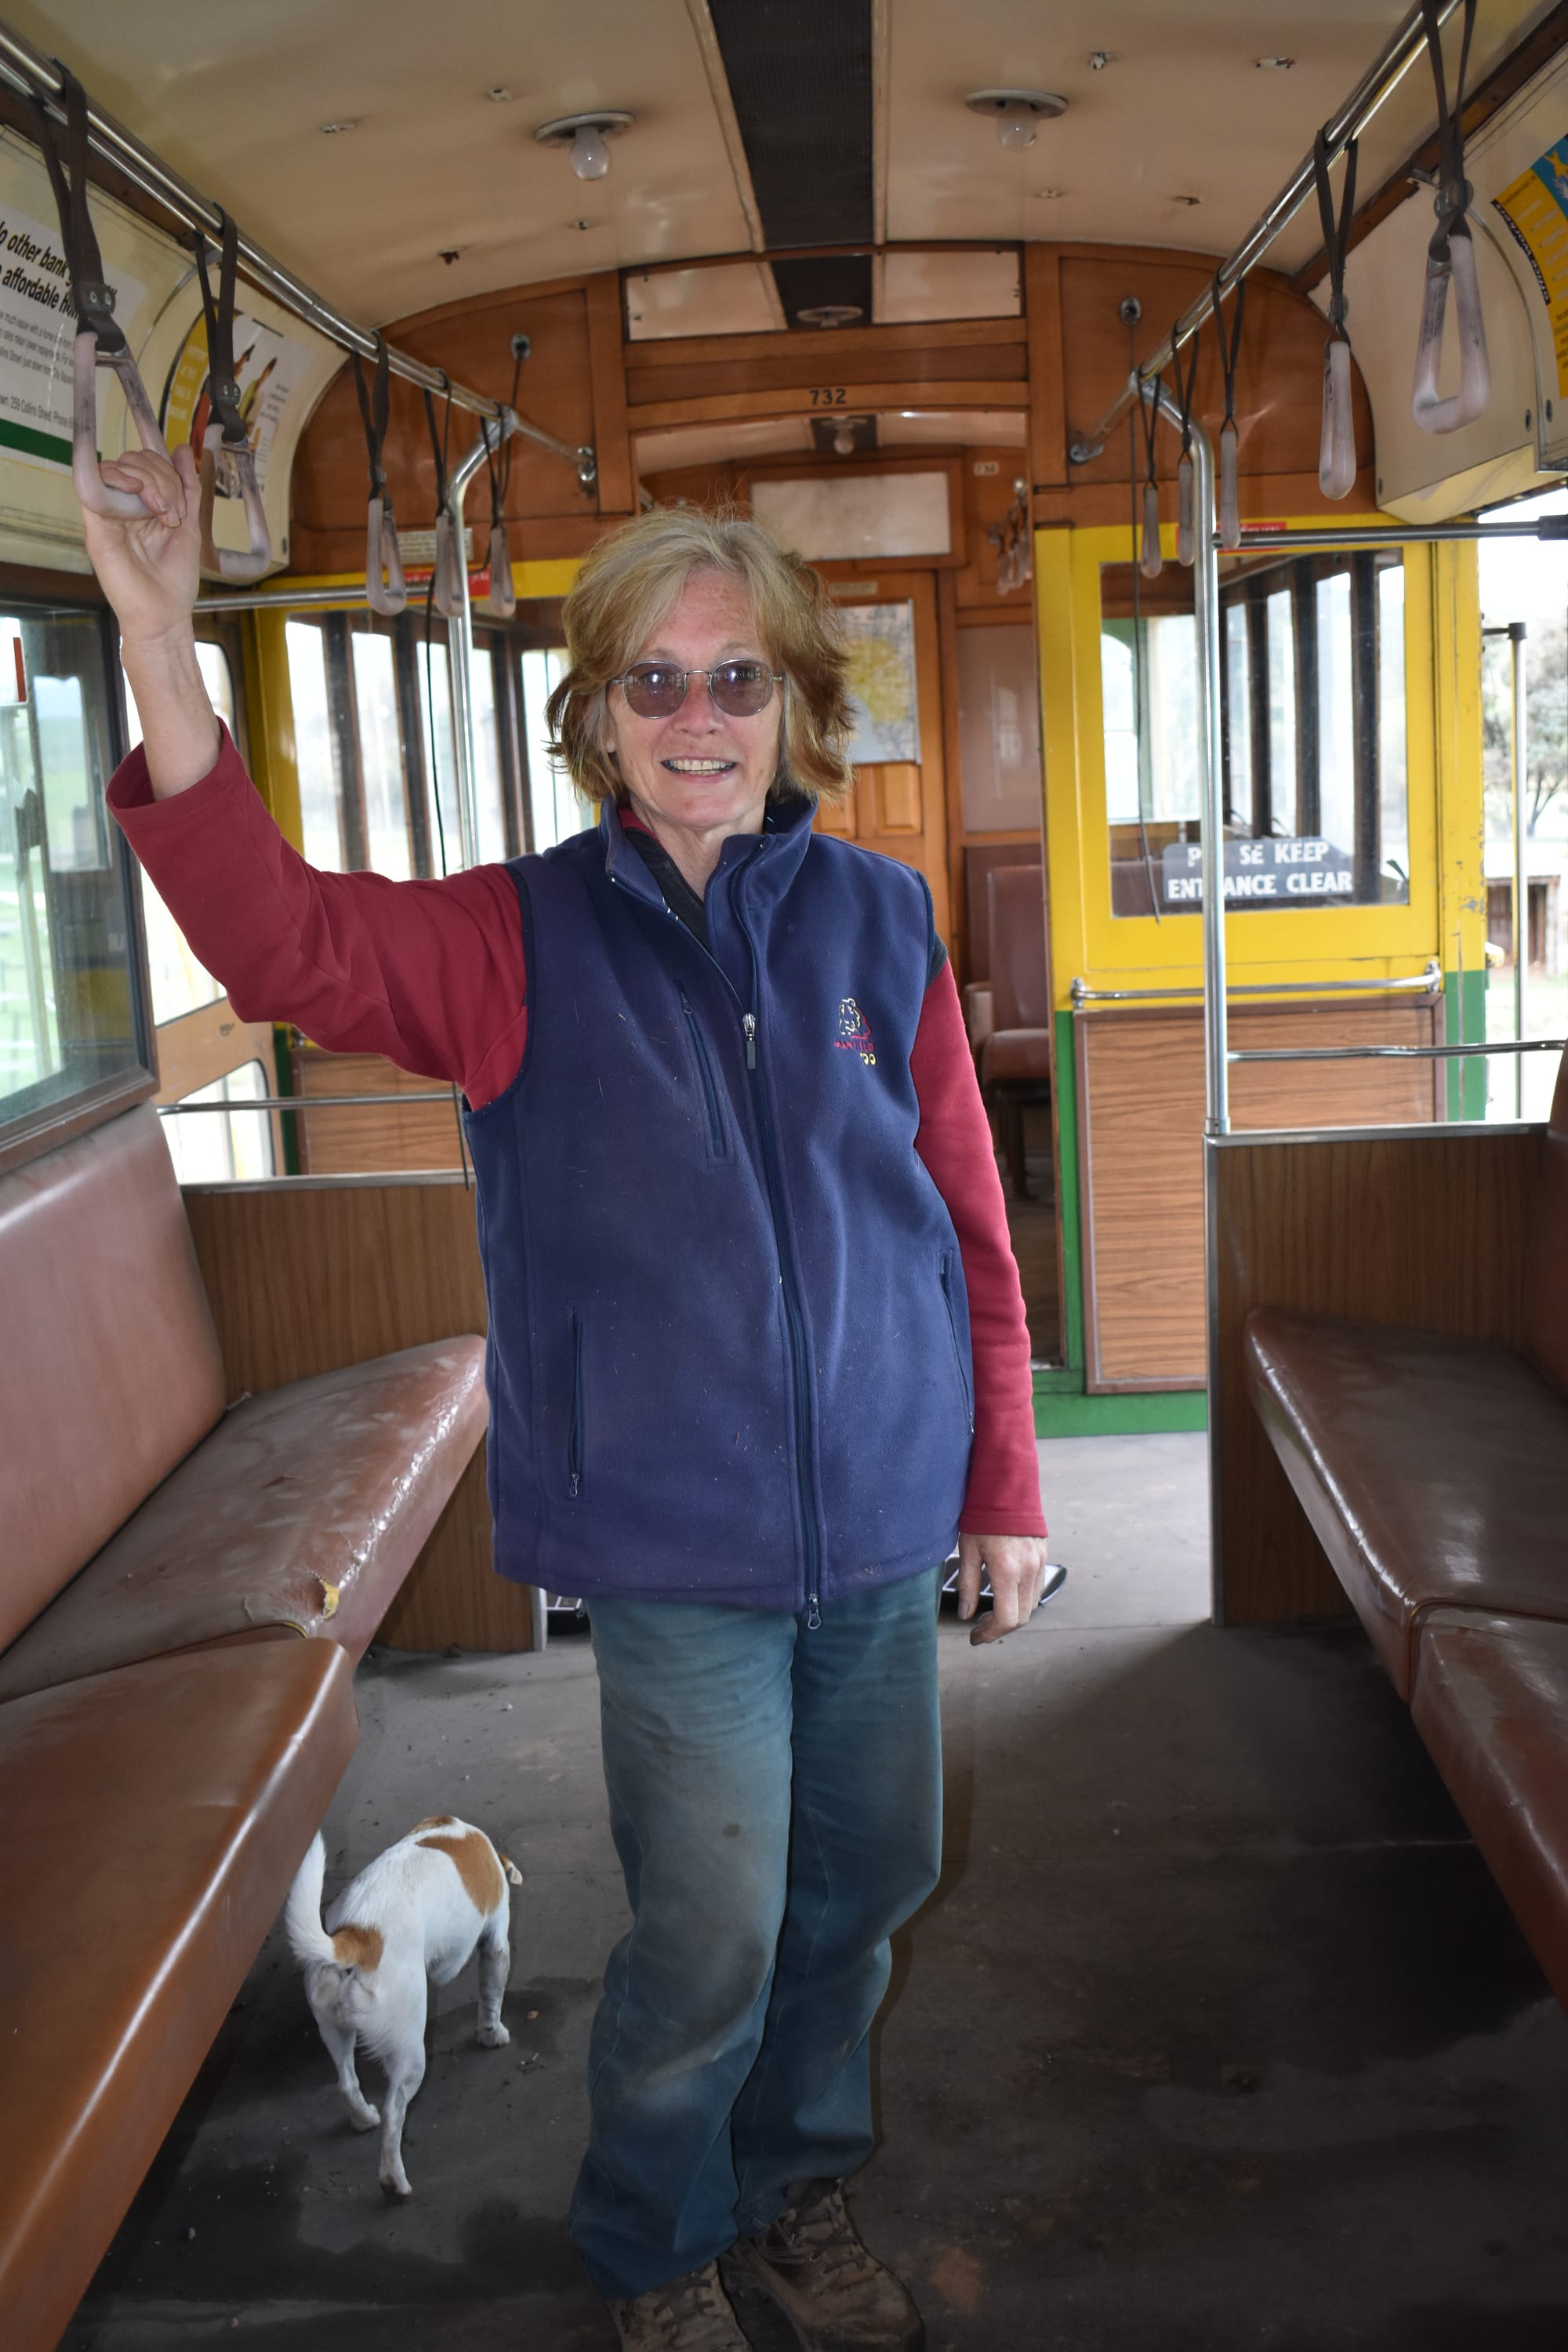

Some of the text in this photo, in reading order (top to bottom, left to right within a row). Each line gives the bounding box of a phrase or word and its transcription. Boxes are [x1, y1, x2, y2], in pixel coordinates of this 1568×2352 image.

[7, 234, 42, 263] other
[39, 246, 69, 278] bank
[2, 267, 60, 309] affordable
[809, 388, 847, 405] 732
[1274, 841, 1329, 864] KEEP
[1167, 870, 1354, 899] ENTANCE CLEAR
